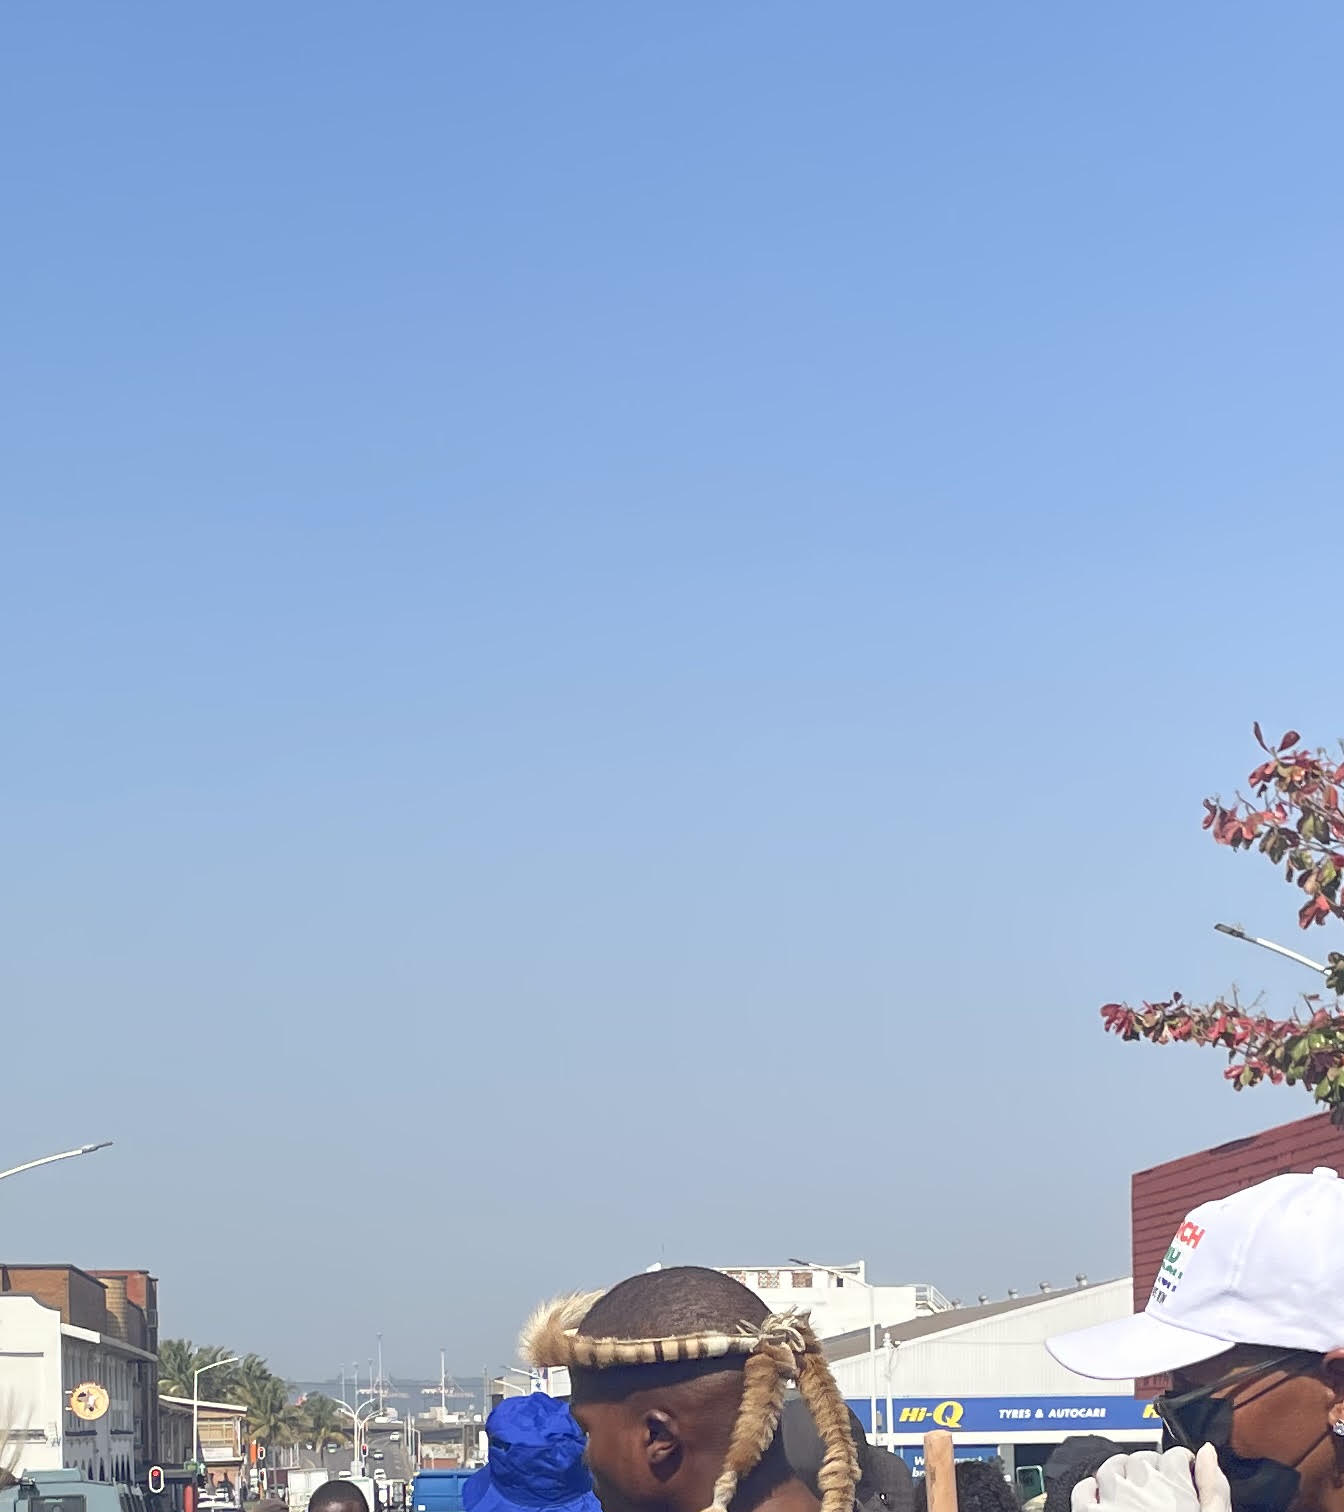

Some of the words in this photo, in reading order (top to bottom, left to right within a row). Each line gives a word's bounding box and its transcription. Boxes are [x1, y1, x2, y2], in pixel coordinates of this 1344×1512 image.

[999, 1409, 1031, 1419] TYRES
[1035, 1409, 1044, 1418] &
[1048, 1408, 1106, 1418] AUTOCARE
